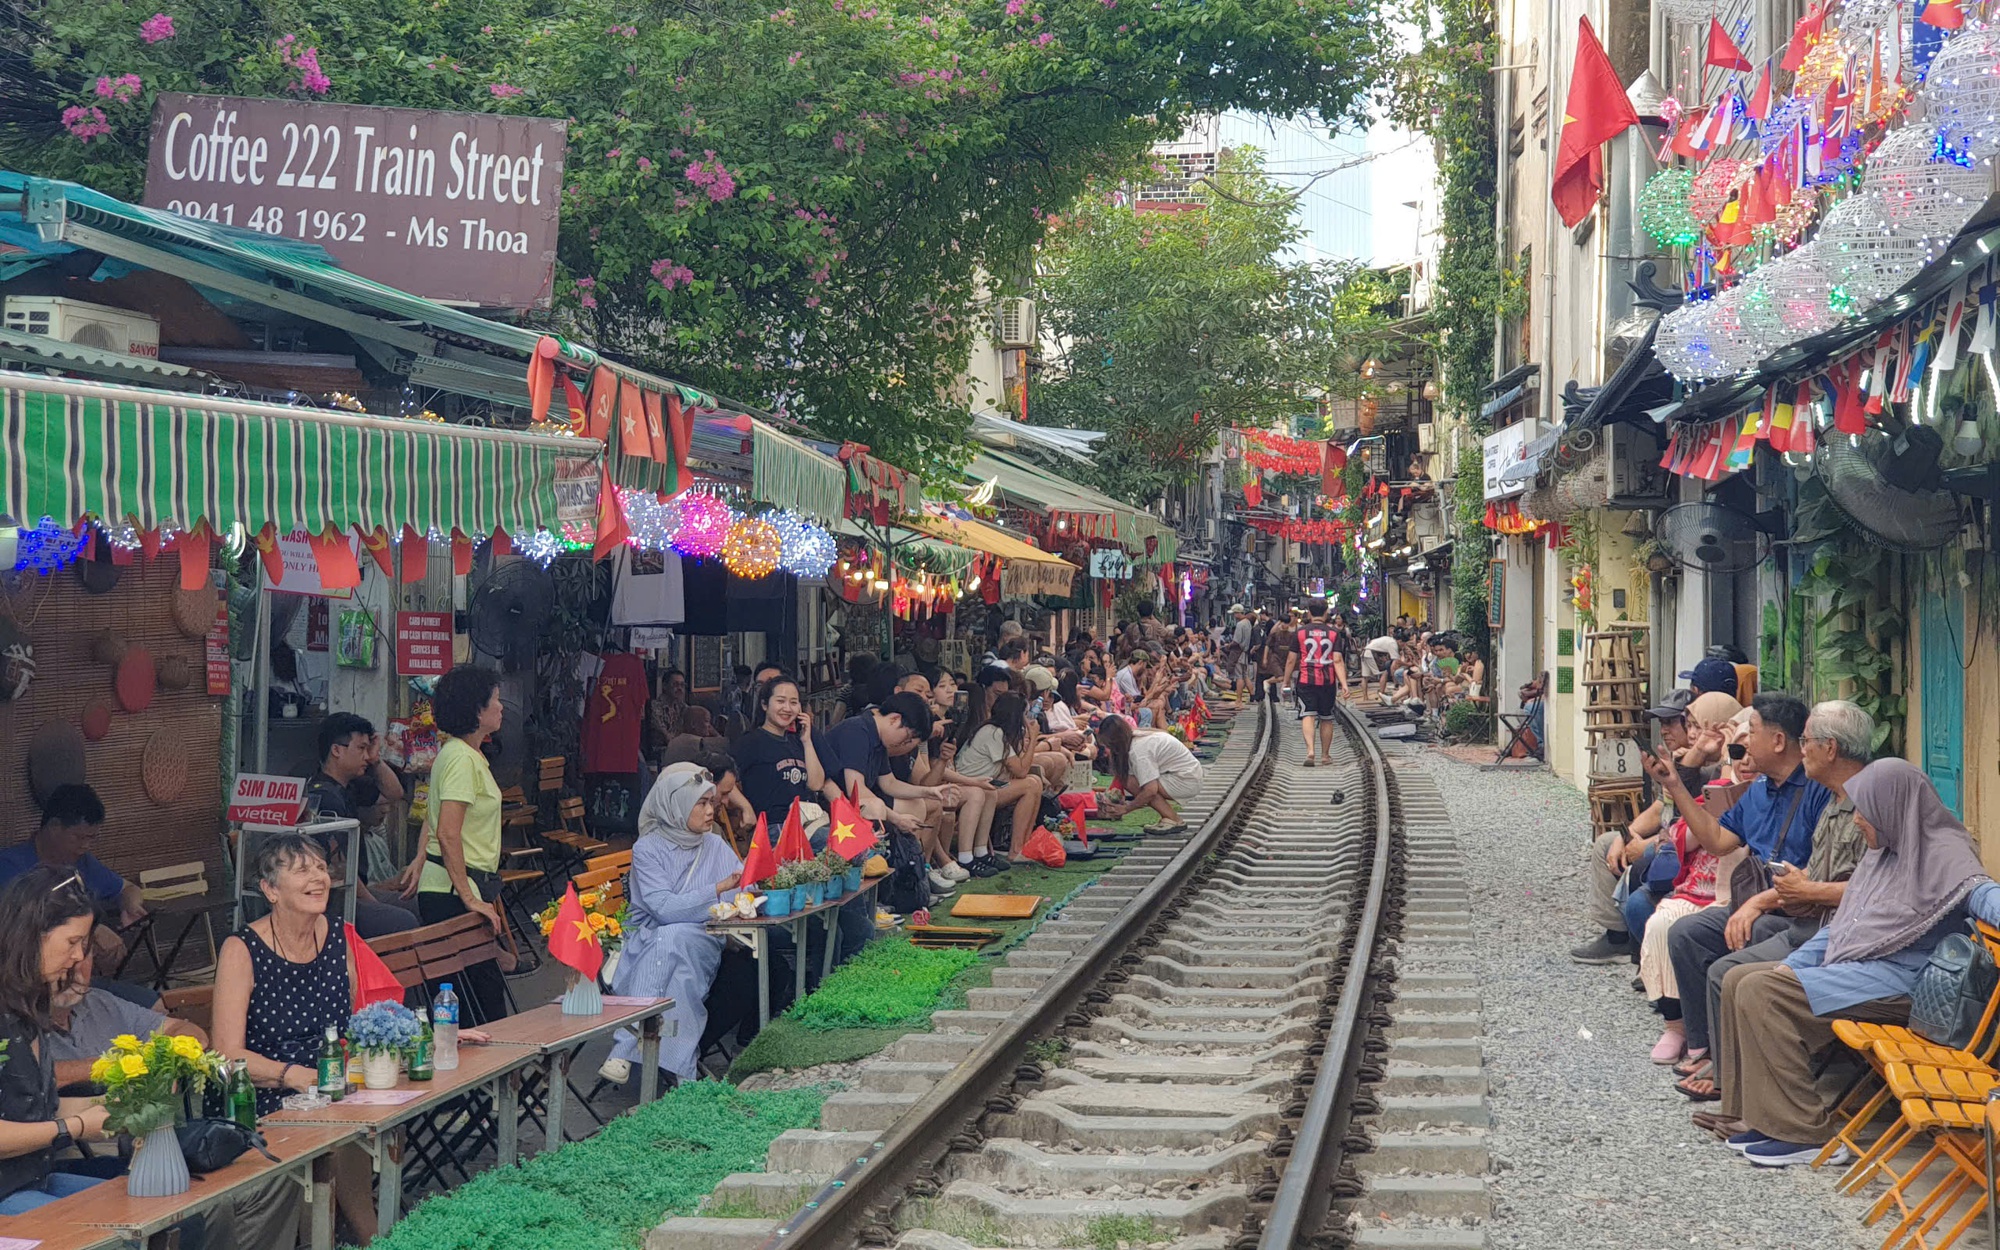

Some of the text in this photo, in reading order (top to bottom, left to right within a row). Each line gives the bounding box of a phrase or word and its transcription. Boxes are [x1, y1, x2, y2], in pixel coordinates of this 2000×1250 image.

[165, 110, 544, 206] Coffee 222 Train Street
[247, 205, 284, 235] 48
[296, 208, 367, 242] 1962
[405, 216, 449, 248] Ms
[460, 218, 528, 255] Thoa
[129, 343, 158, 357] SANYO
[281, 529, 308, 544] WASH
[283, 561, 307, 572] ONLY
[410, 644, 440, 655] SERVICES ARE
[1303, 637, 1334, 665] 22
[408, 658, 443, 669] AVAILABLE HERE
[237, 779, 299, 801] SIM DATA
[236, 807, 288, 822] viettel
